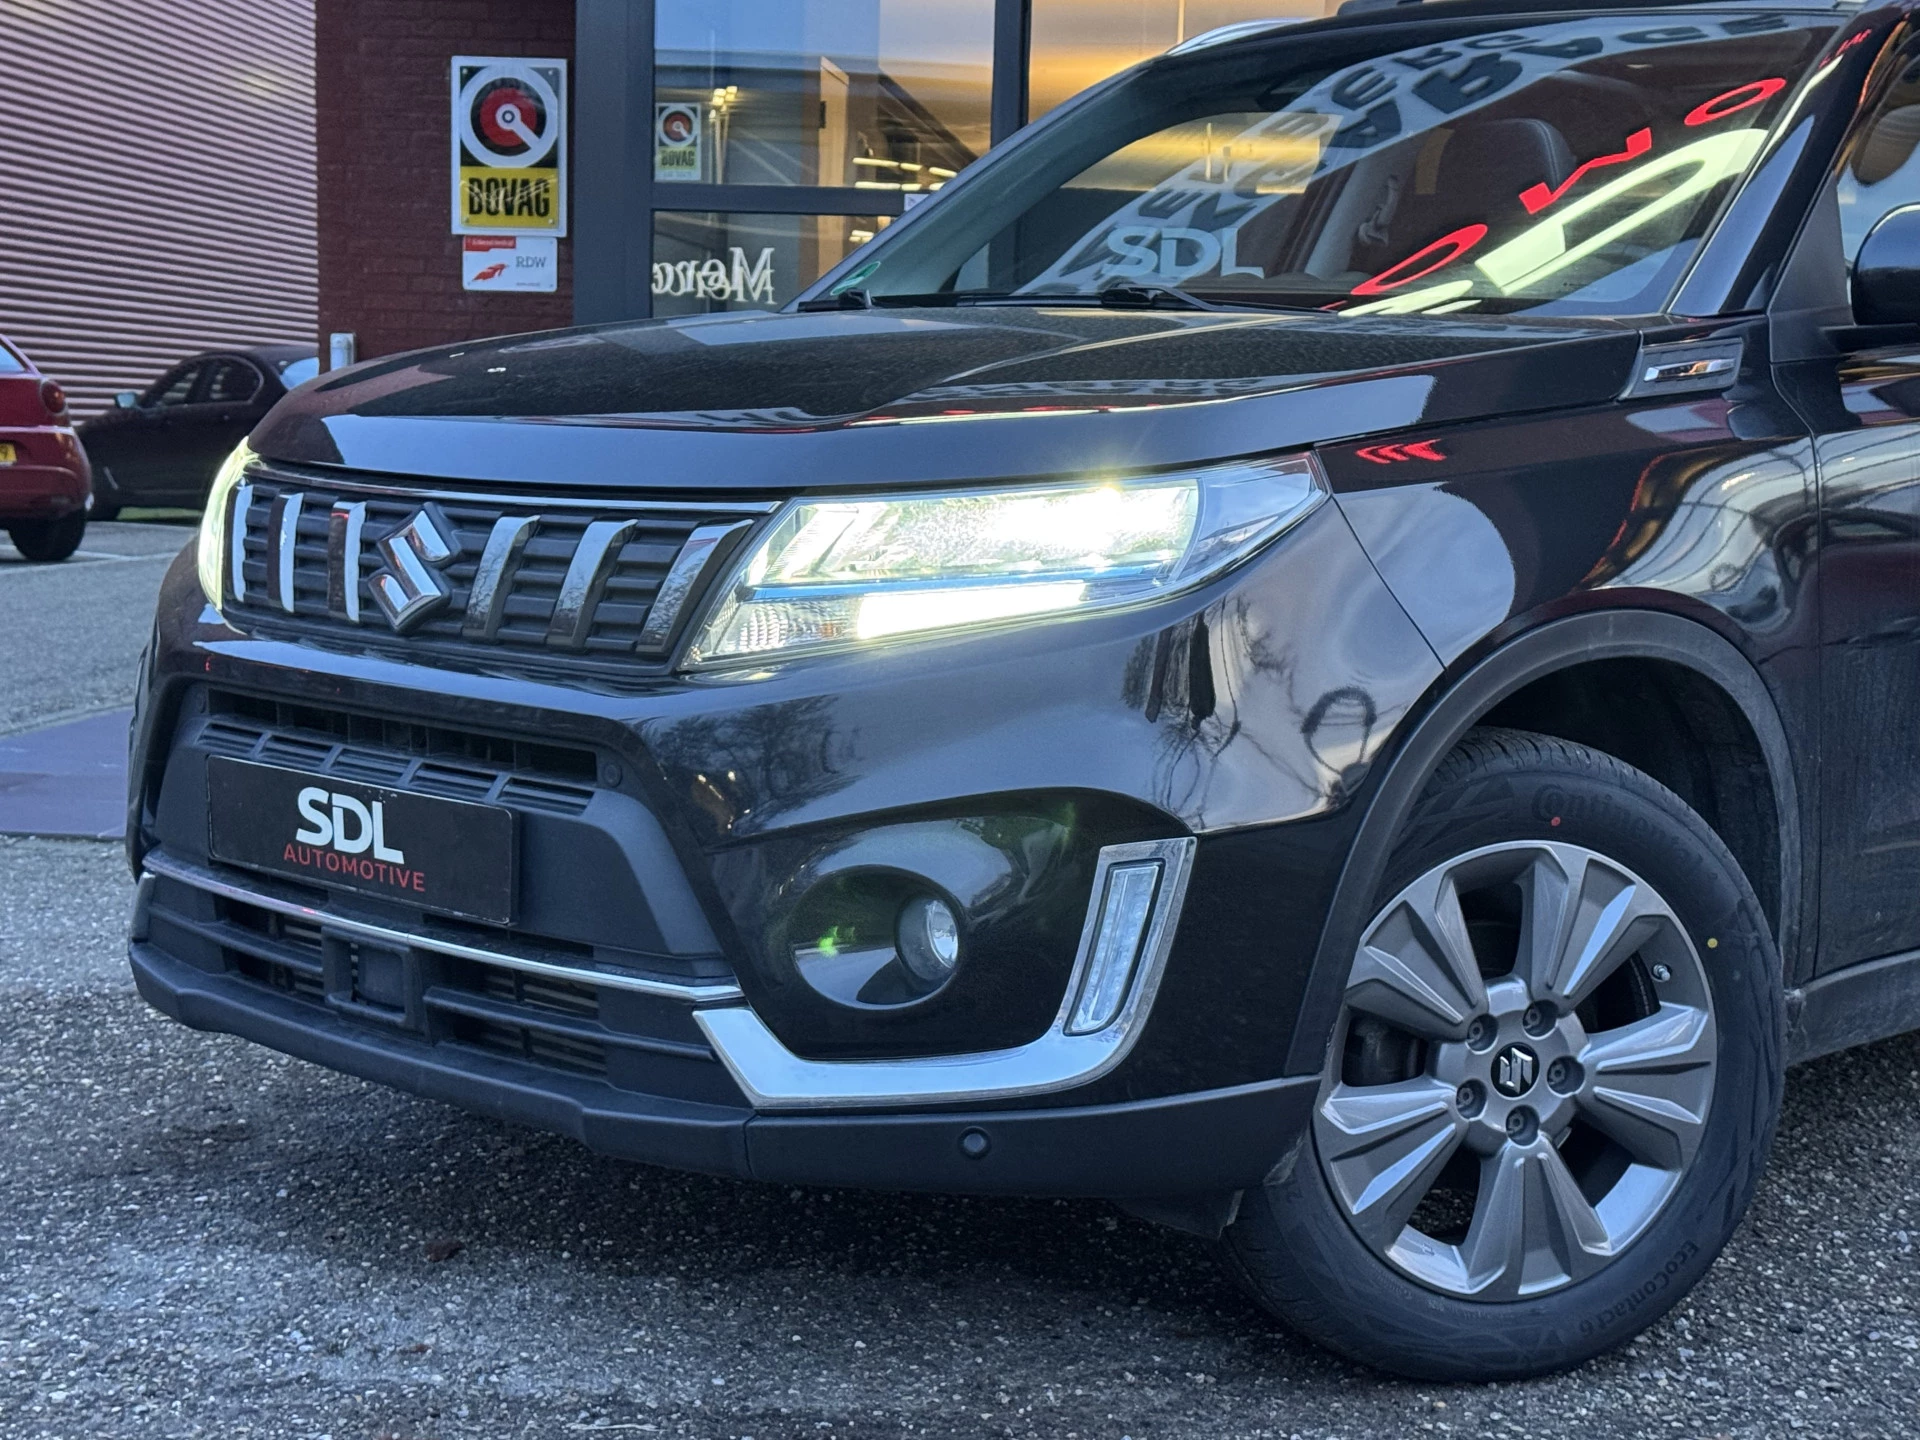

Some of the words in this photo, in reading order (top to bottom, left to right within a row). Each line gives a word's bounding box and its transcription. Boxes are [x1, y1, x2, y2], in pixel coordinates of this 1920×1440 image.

[661, 149, 695, 167] BOVAG
[468, 177, 551, 217] BOVAG
[515, 255, 547, 269] RDW
[1101, 225, 1265, 280] SDL
[295, 786, 405, 865] SDL
[283, 842, 427, 893] AUTOMOTIVE
